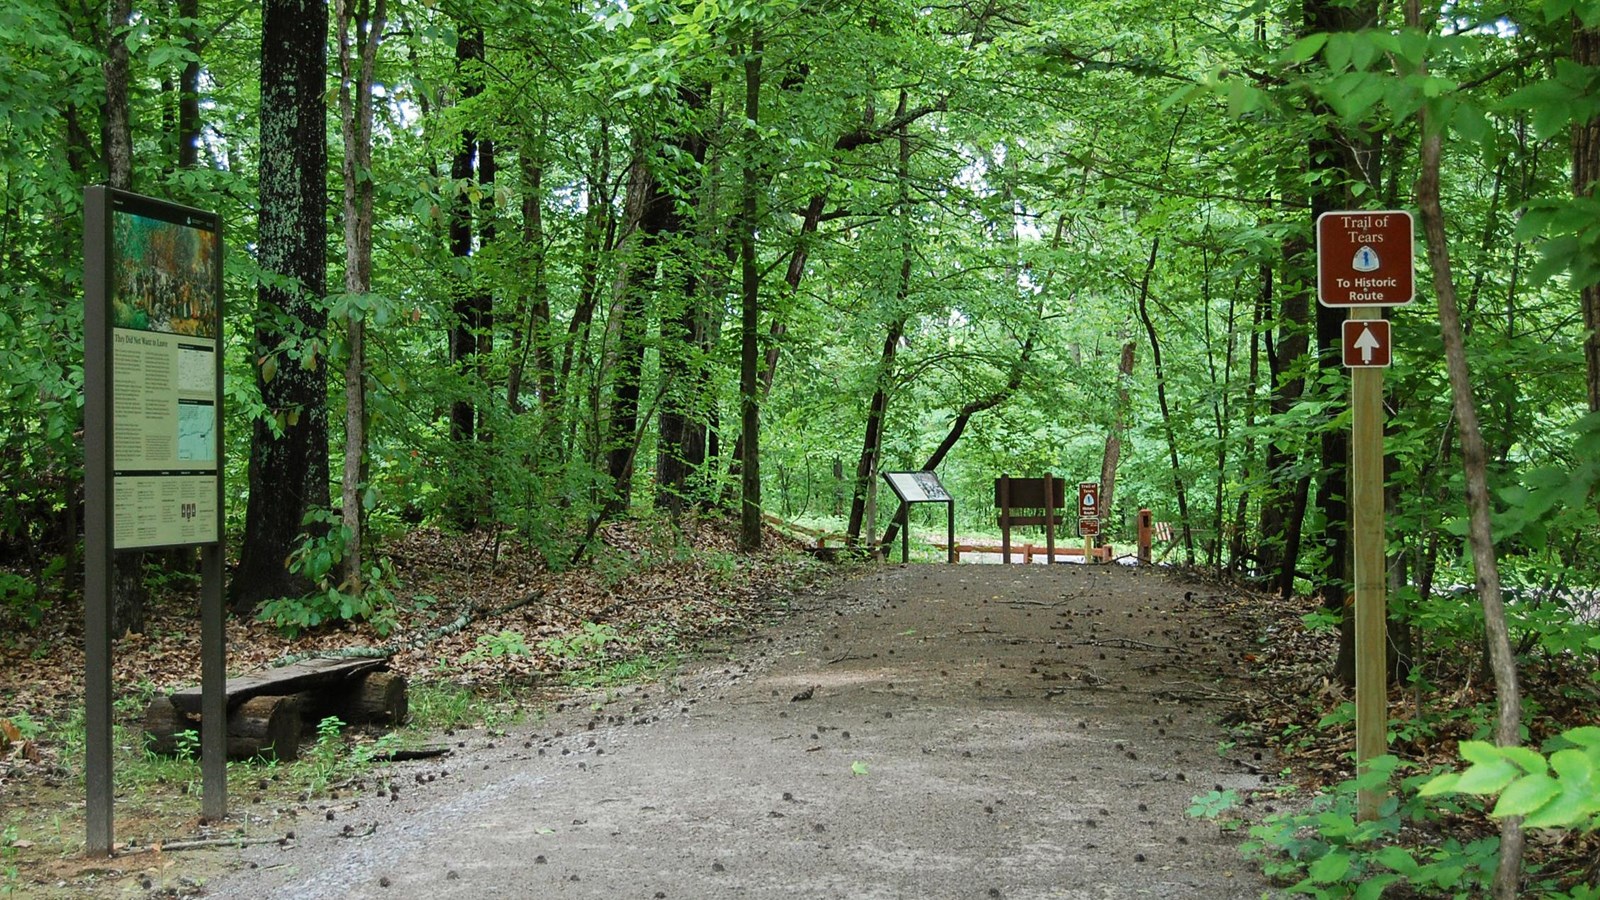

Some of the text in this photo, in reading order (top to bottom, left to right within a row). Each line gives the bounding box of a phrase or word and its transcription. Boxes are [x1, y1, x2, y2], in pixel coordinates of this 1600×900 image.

[1341, 215, 1390, 228] Trail of
[1347, 231, 1384, 243] Tears
[1336, 277, 1397, 288] To Historic
[1349, 291, 1384, 301] Route
[115, 333, 125, 344] They
[125, 334, 133, 344] Did
[133, 336, 141, 345] Not
[141, 337, 152, 346] Want
